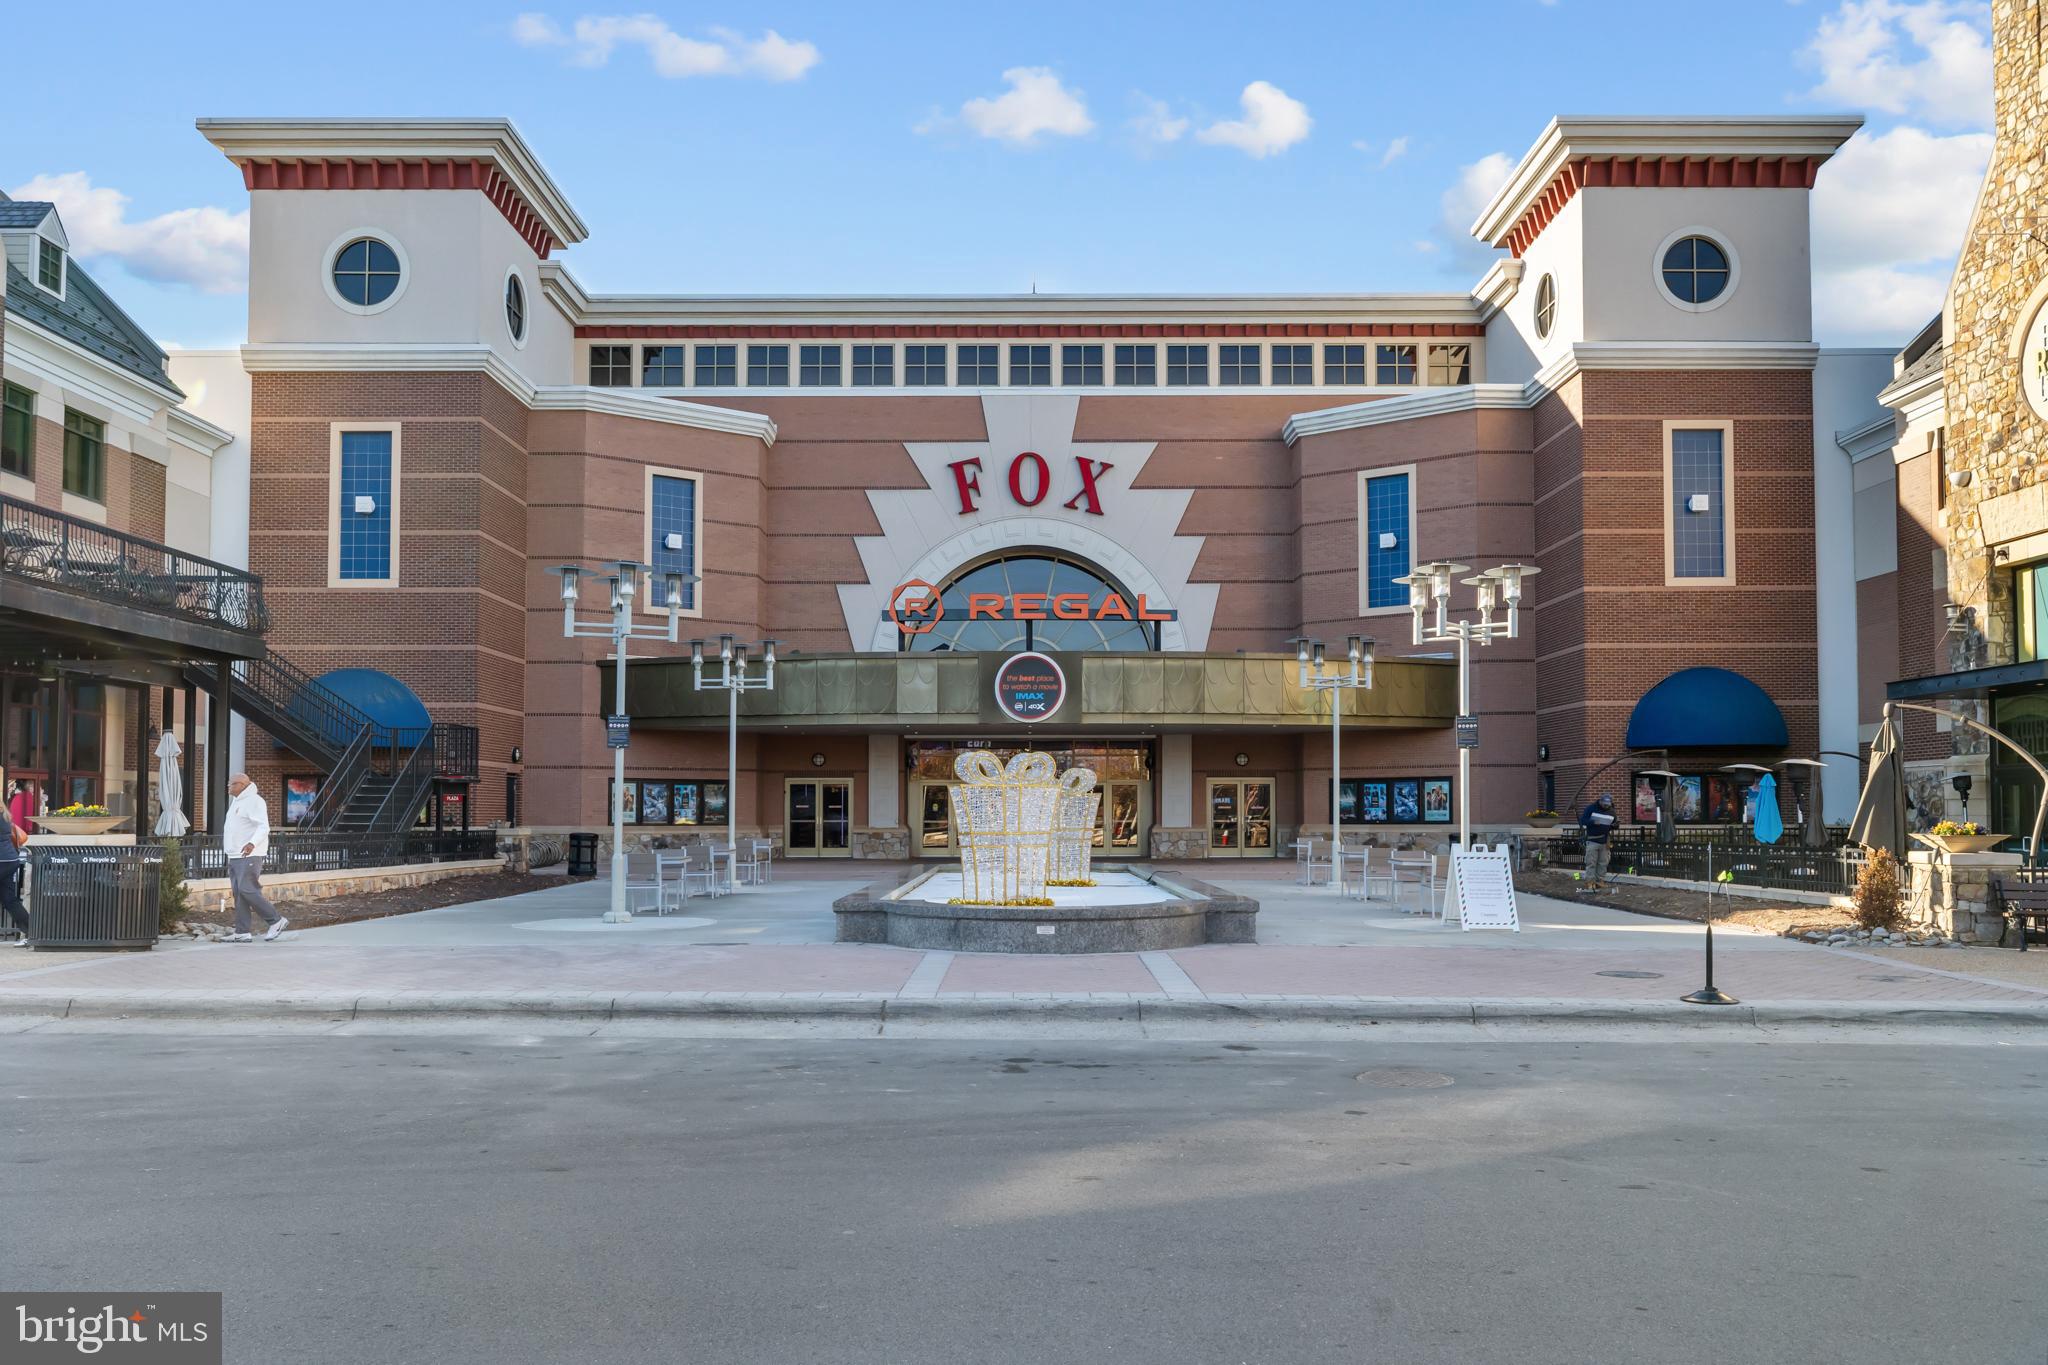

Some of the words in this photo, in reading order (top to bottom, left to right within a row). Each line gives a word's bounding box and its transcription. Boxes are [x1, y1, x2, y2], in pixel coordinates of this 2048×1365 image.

[948, 452, 1114, 516] FOX
[969, 593, 1172, 620] REGAL
[1036, 675, 1054, 683] place
[51, 856, 69, 864] Trash
[89, 856, 110, 864] Recycle
